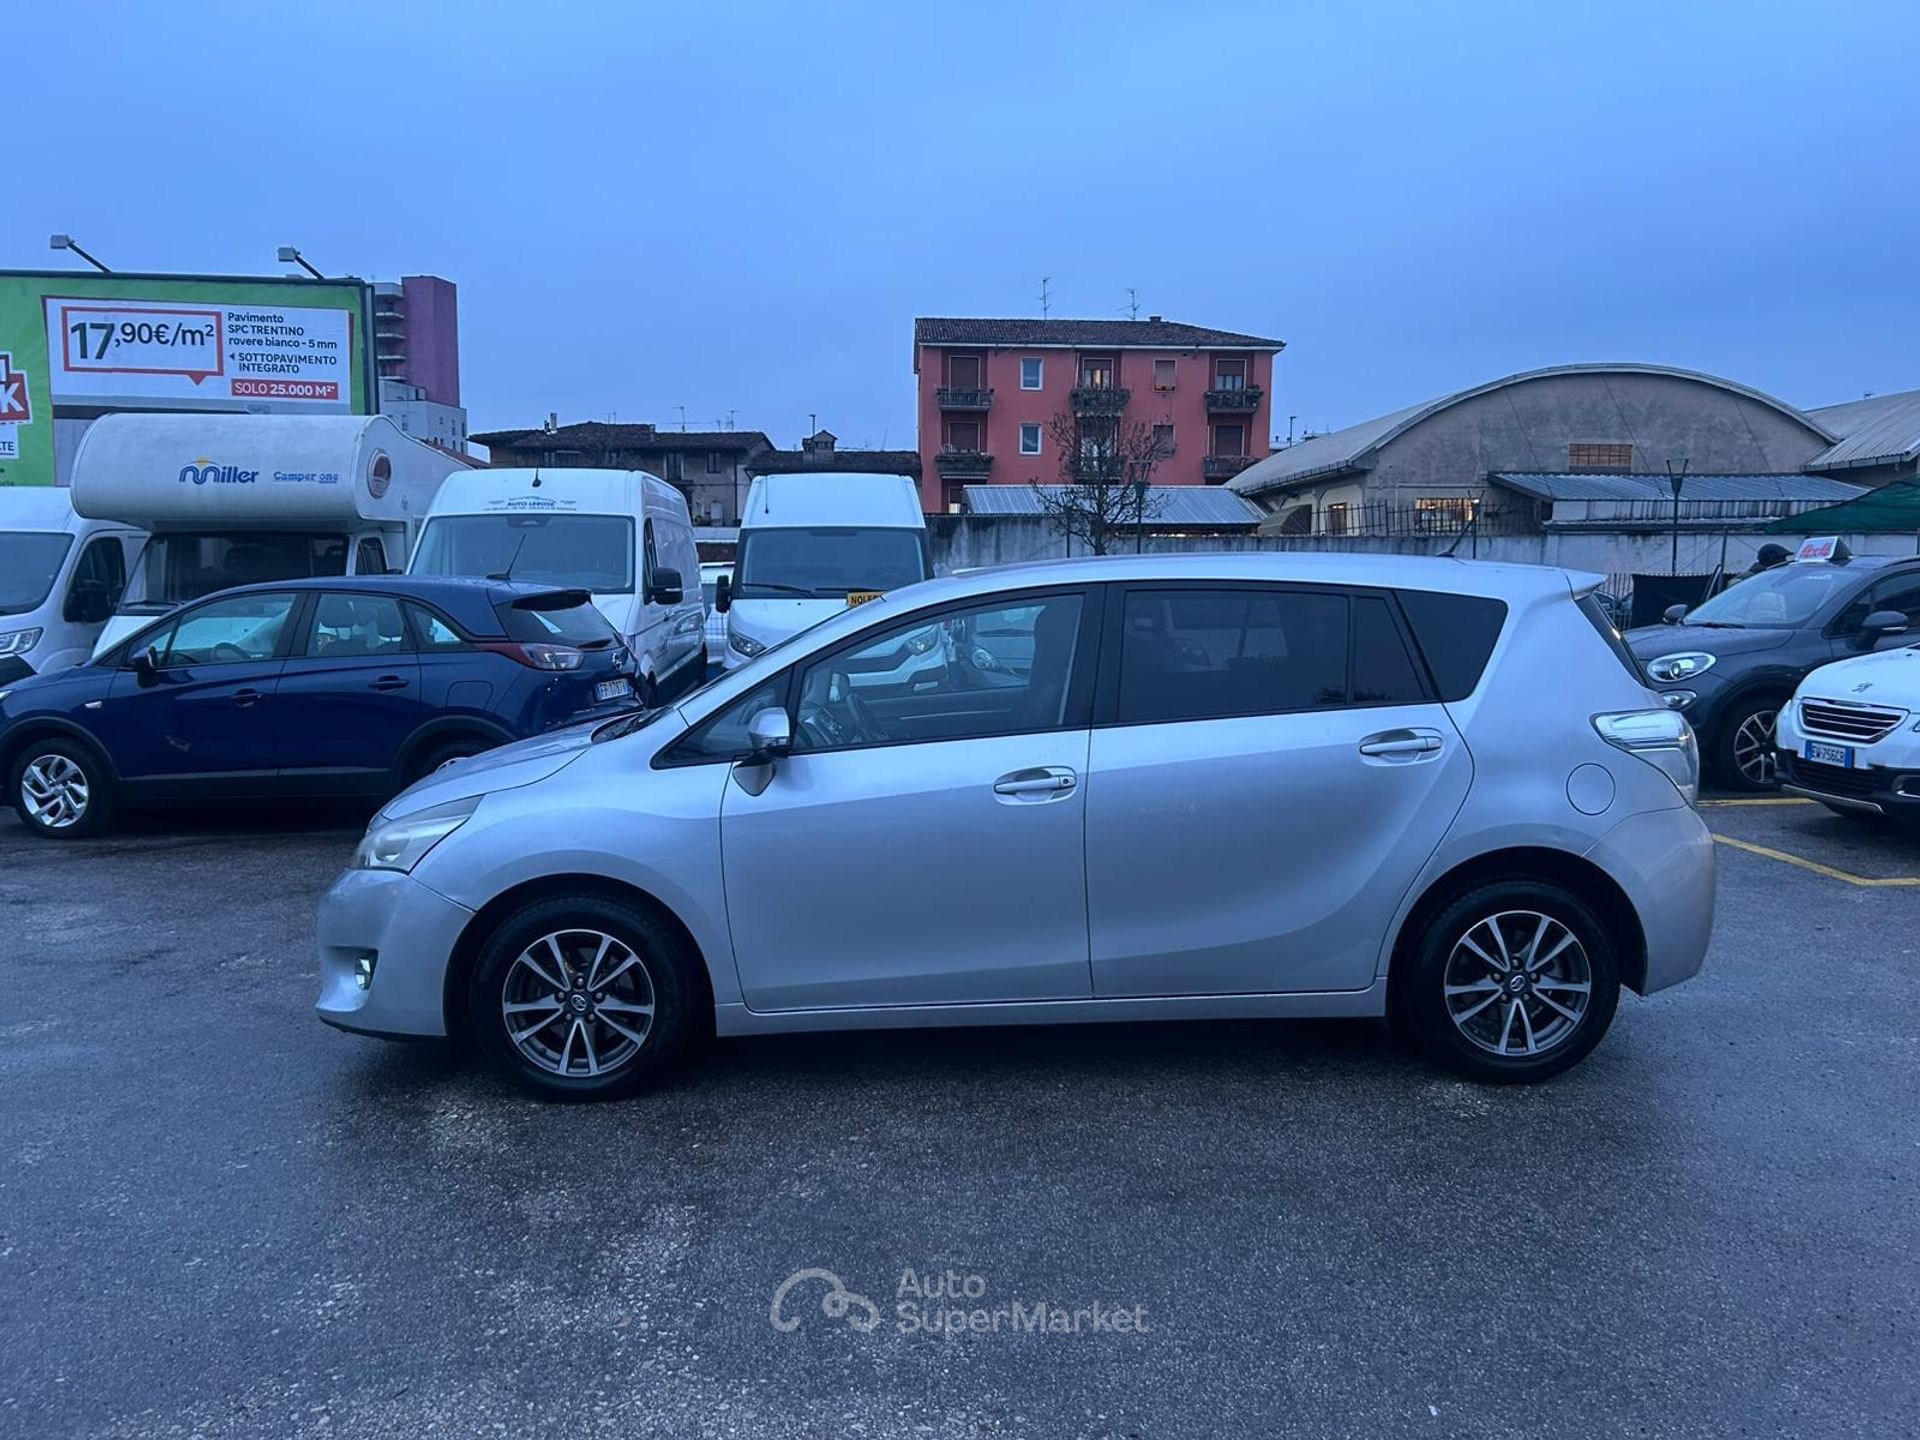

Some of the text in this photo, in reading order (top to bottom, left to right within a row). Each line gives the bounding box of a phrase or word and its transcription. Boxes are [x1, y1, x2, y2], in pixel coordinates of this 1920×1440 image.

[228, 312, 284, 324] Pavimento
[228, 324, 304, 336] SPC TRENTINO
[228, 338, 263, 347] rovere
[265, 337, 300, 348] bianco
[308, 339, 316, 348] 5
[317, 341, 337, 349] mm
[238, 352, 337, 365] SOTTOPAVIMENTO
[238, 363, 300, 374] INTEGRATO
[235, 383, 267, 395] SOLO
[270, 384, 313, 396] 25.000
[179, 465, 259, 485] Miller
[273, 471, 316, 482] Camper
